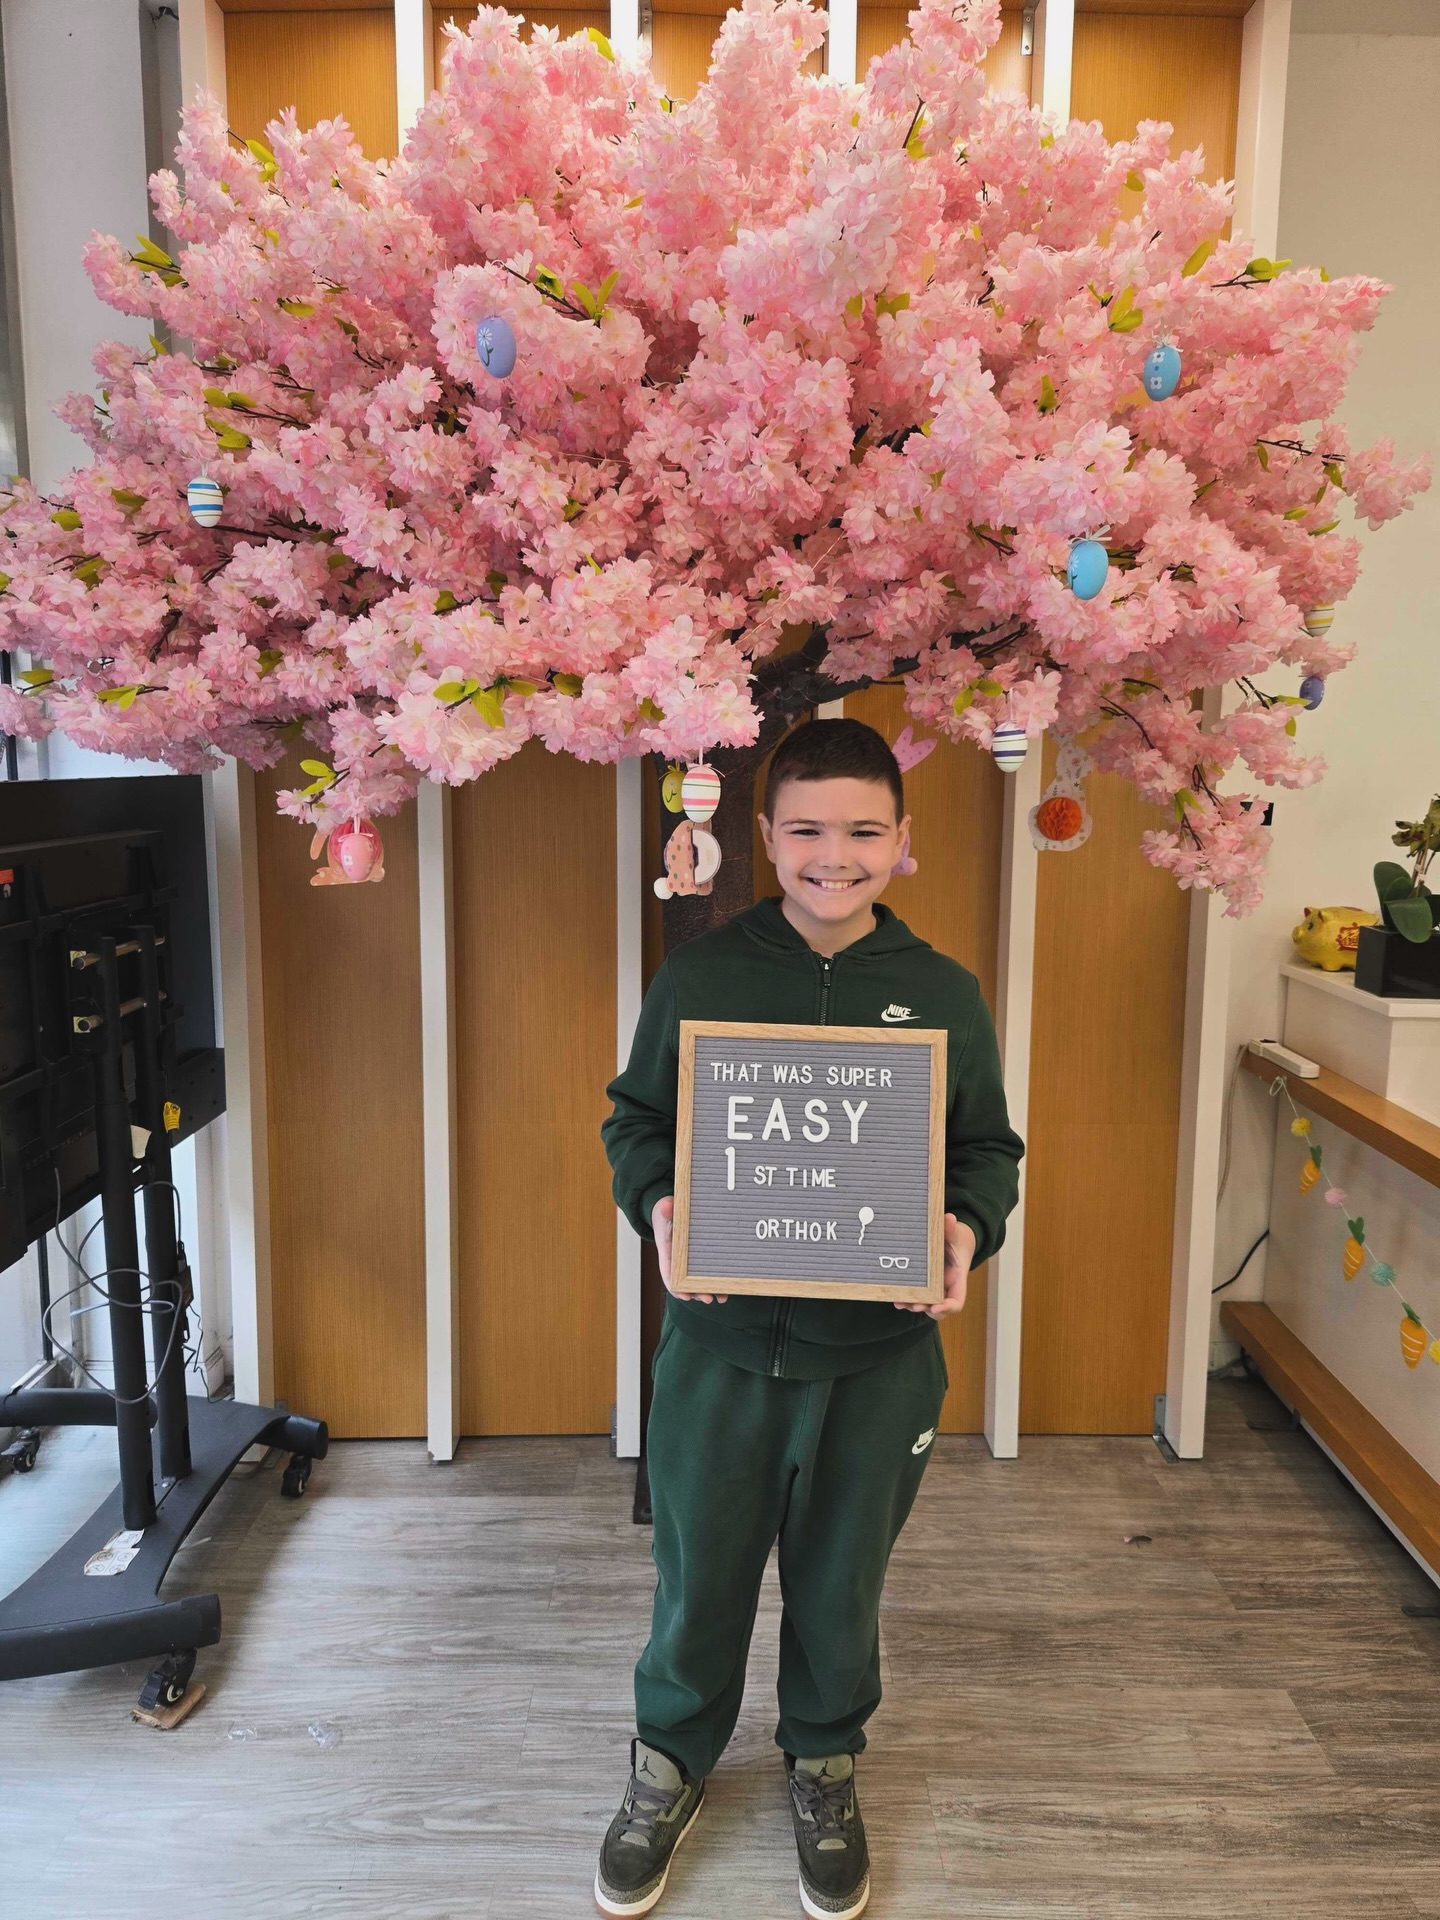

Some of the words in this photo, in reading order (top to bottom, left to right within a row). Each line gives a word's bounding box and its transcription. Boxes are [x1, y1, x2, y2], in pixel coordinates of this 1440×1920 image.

[887, 1003, 912, 1018] NIKE
[710, 1062, 762, 1083] THAT
[773, 1065, 813, 1084] WAS
[826, 1066, 892, 1088] SUPER
[727, 1095, 868, 1144] EASY
[724, 1146, 736, 1191] 1
[753, 1165, 778, 1187] ST
[785, 1167, 836, 1188] TIME
